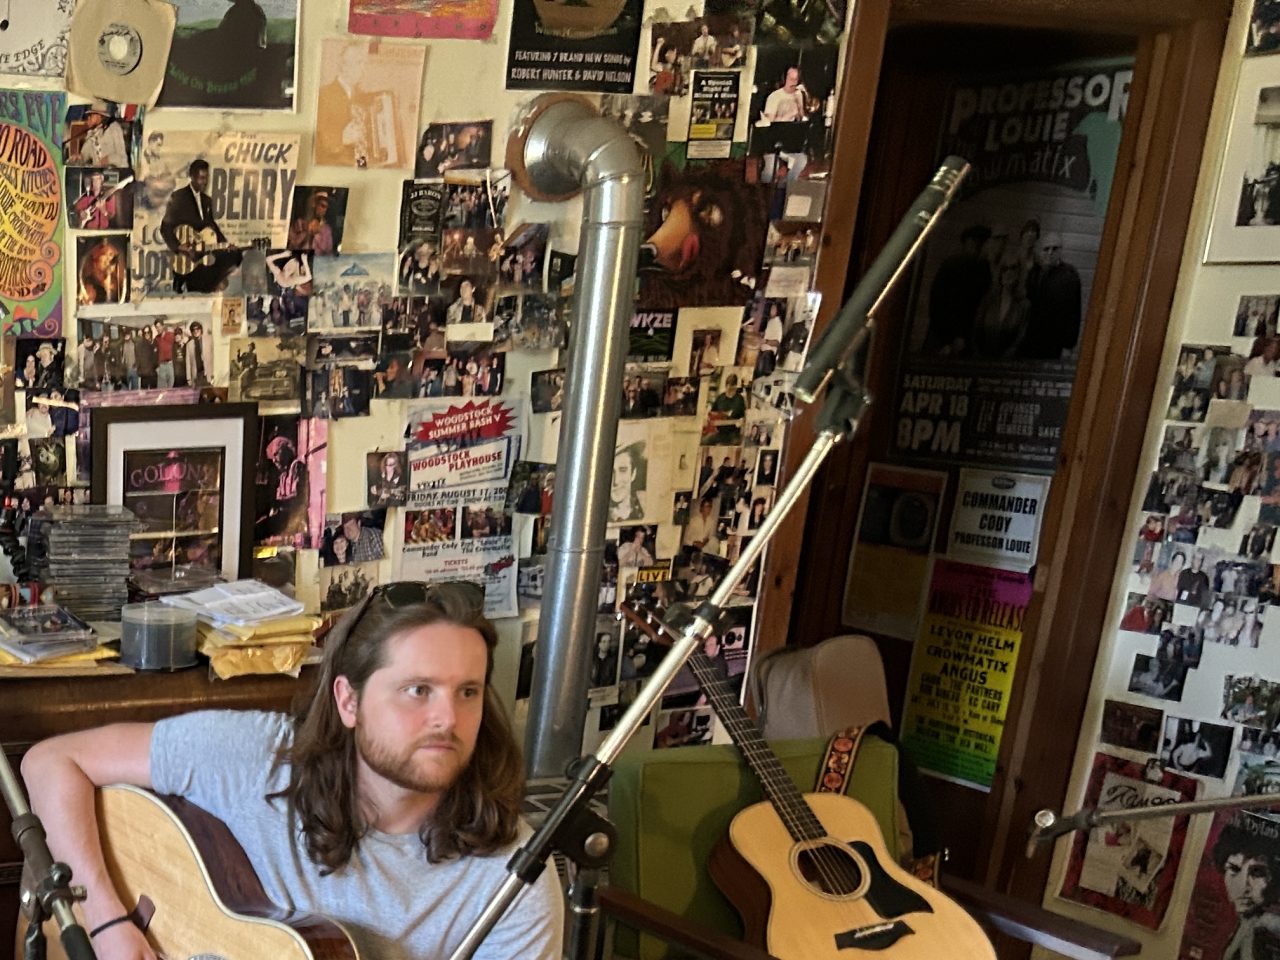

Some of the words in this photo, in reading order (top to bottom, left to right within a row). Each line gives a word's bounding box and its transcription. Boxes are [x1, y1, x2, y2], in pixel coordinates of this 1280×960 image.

[14, 39, 46, 61] EDGE
[515, 50, 551, 63] FEATURING
[559, 51, 584, 63] BRAND
[585, 52, 603, 64] NEW
[511, 68, 542, 80] ROBERT
[542, 68, 572, 81] HUNTER
[583, 70, 605, 82] DAVID
[605, 71, 632, 83] NELSON
[949, 69, 1134, 136] PROFESSOR
[984, 111, 1071, 152] LOUIE
[7, 129, 48, 168] ROAD
[223, 142, 293, 164] CHUCK
[211, 167, 297, 221] BERRY
[903, 372, 973, 392] SATURDAY
[899, 390, 944, 416] APR
[428, 422, 468, 440] SUMMER
[469, 414, 493, 430] BASH
[493, 413, 501, 422] V
[434, 408, 493, 428] WOODSTOCK
[412, 450, 471, 472] WOODSTOCK
[448, 451, 503, 473] PLAYHOUSE
[440, 488, 477, 499] AUGUST
[962, 490, 1038, 515] COMMANDER
[978, 513, 1013, 533] CODY
[954, 531, 1004, 550] PROFESSOR
[1005, 538, 1031, 554] LOUIE
[639, 570, 668, 582] LIVE
[930, 623, 973, 641] LEVON
[977, 633, 1015, 653] HELM
[926, 644, 1009, 673] CROWMATIX
[940, 662, 988, 685] ANGUS
